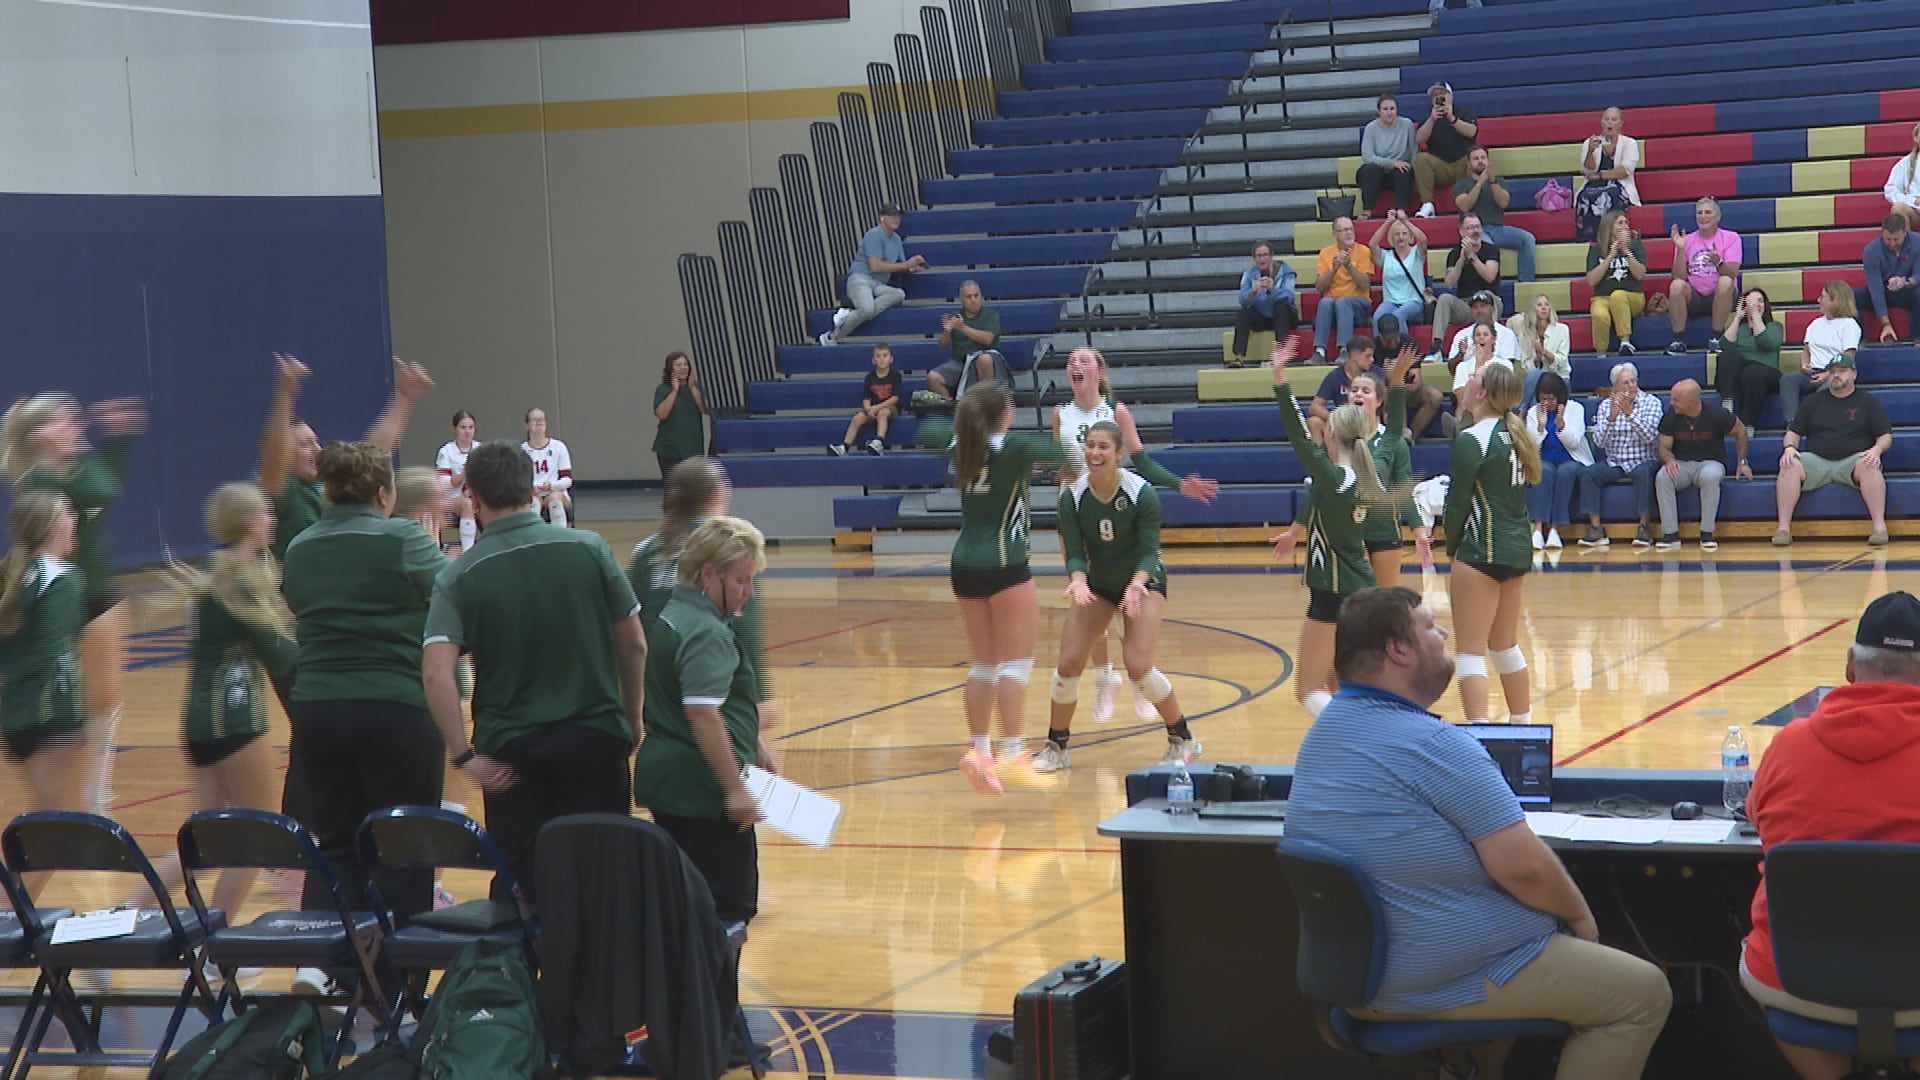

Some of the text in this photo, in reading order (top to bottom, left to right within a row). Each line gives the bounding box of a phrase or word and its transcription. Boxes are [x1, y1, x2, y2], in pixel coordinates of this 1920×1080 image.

[534, 459, 549, 474] 14
[964, 465, 992, 496] 2
[1099, 519, 1115, 541] 9
